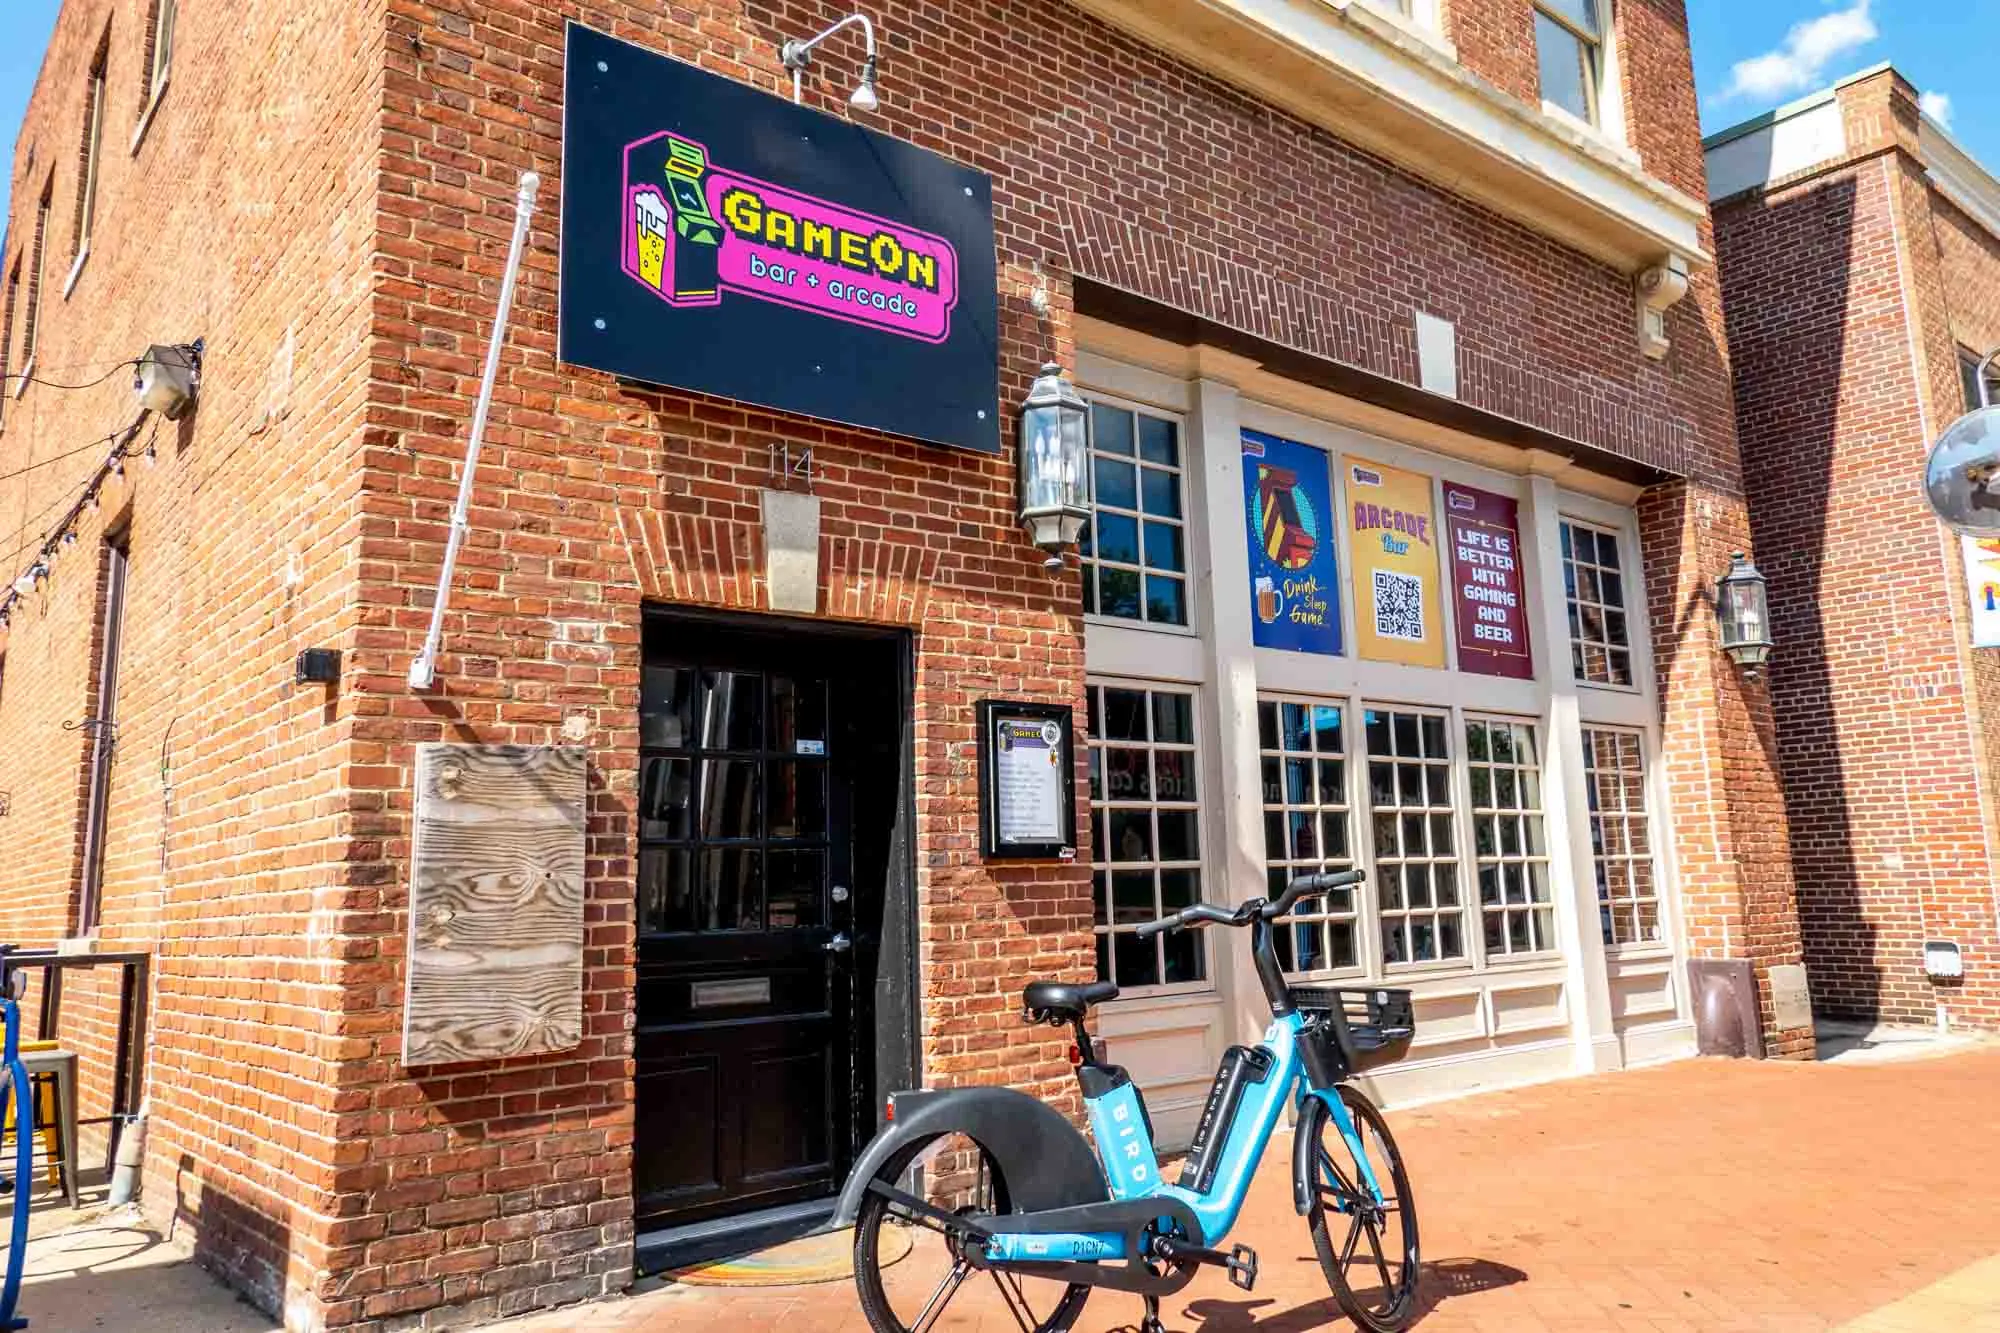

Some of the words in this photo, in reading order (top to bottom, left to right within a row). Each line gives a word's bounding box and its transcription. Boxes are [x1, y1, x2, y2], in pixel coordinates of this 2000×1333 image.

[750, 253, 797, 285] bar
[807, 273, 819, 288] +
[828, 280, 918, 317] arcade
[767, 443, 814, 486] 114
[1354, 501, 1430, 546] ARCADE
[1457, 527, 1492, 548] LIFE
[1494, 536, 1510, 552] IS
[1458, 546, 1514, 572] BETTER
[1472, 567, 1506, 588] WITH
[1463, 584, 1517, 608] GAMING
[1478, 605, 1506, 623] AND
[1474, 623, 1513, 643] BEER
[1112, 1102, 1148, 1183] BIRD
